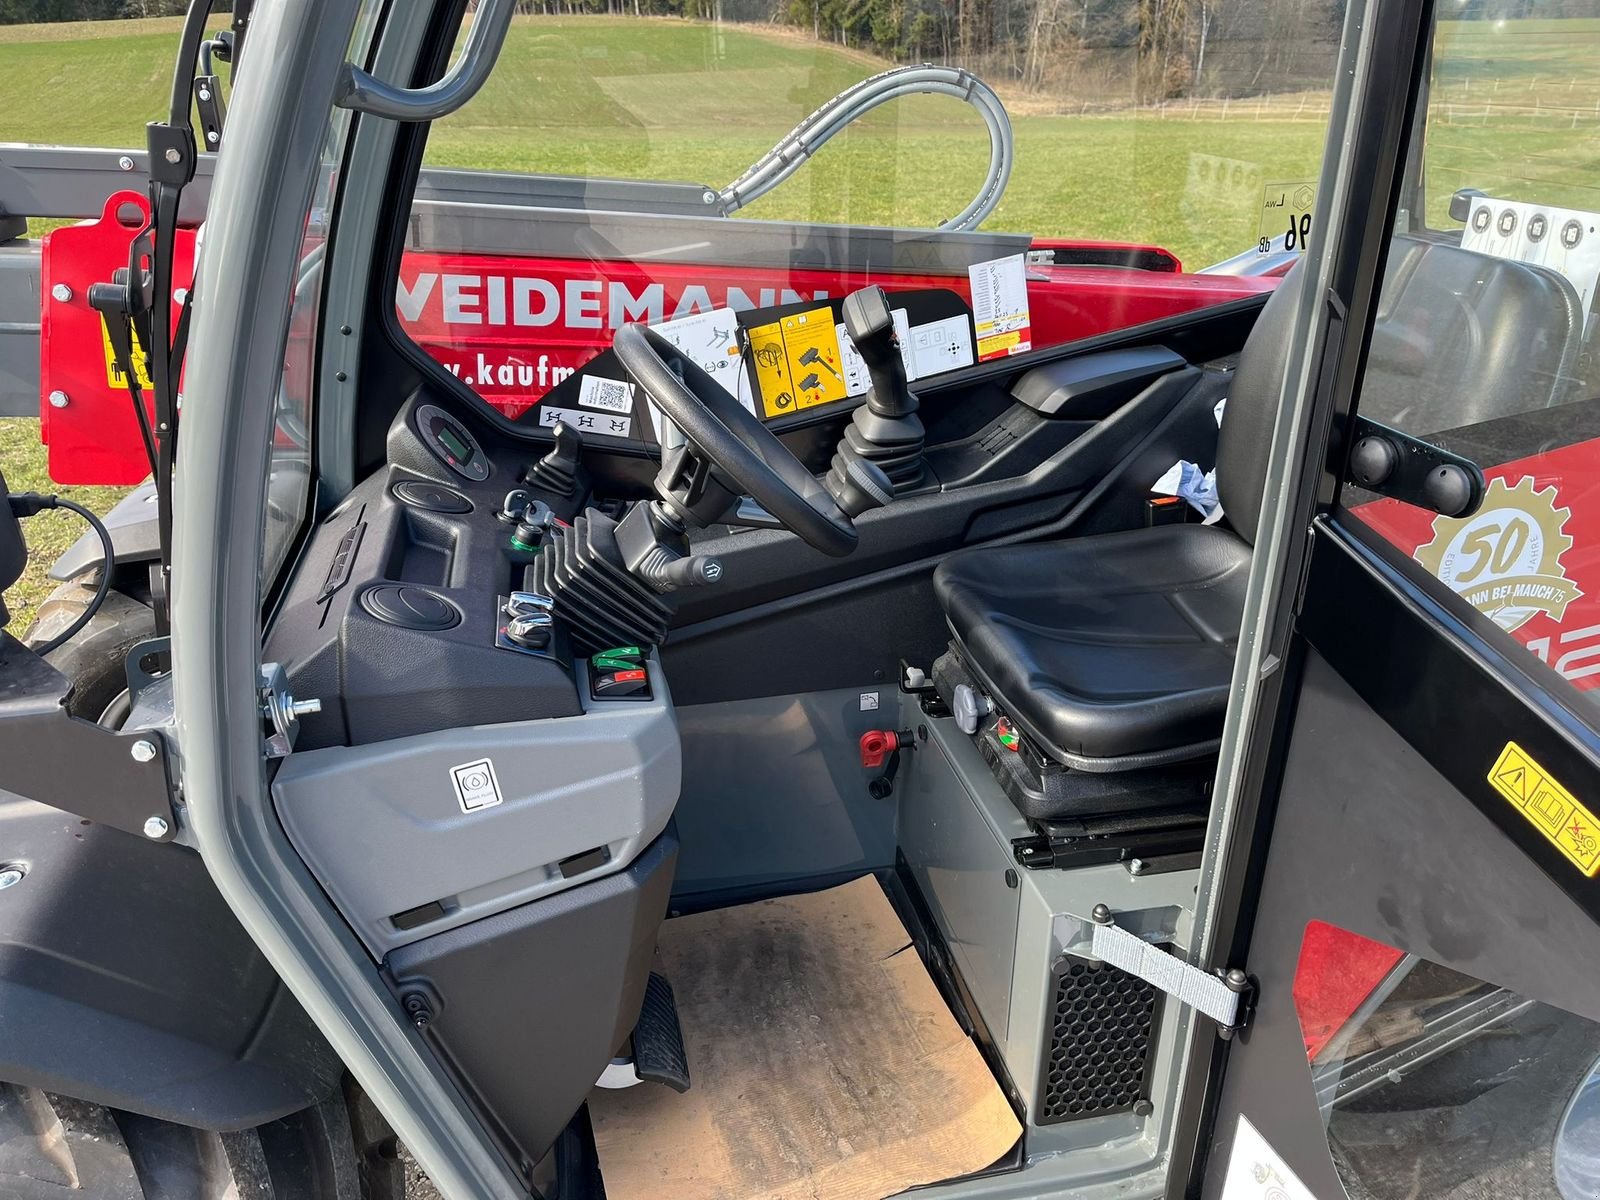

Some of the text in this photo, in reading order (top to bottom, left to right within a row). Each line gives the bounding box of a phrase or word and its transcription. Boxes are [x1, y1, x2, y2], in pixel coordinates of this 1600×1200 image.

[395, 272, 829, 332] EIDEMA
[1455, 517, 1529, 583] 50
[1527, 535, 1539, 572] JAHRE
[1442, 552, 1455, 587] EDITIO
[1512, 583, 1555, 601] MAUCH
[1551, 588, 1567, 604] 75
